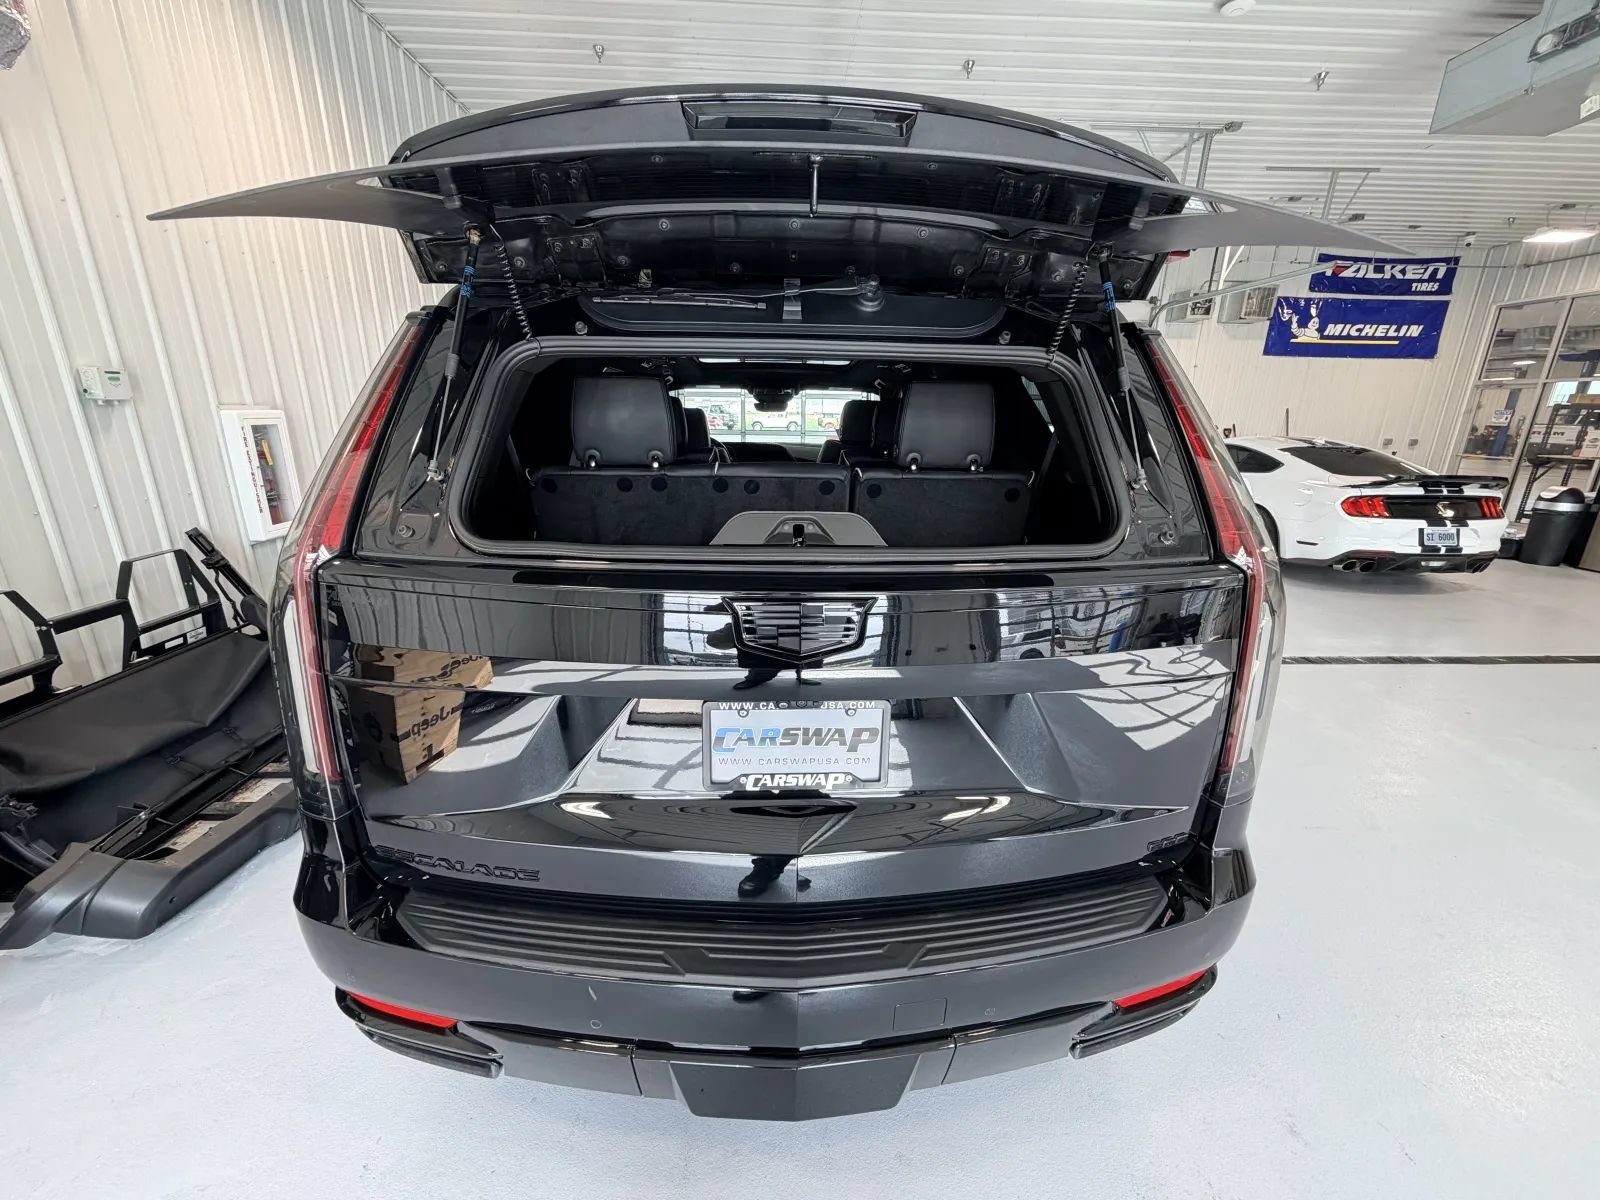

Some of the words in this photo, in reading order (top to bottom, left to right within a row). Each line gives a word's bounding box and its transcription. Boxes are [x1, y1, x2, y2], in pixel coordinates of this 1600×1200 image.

[1325, 260, 1447, 280] FALKEN
[1411, 282, 1440, 292] TIRES
[1324, 323, 1425, 338] MICHELIN
[1438, 533, 1455, 541] 6000
[718, 701, 876, 711] WWW.CAUSA.COM
[712, 727, 880, 753] CARSWAP
[745, 773, 845, 791] CARSWAP
[374, 844, 541, 882] ESCALADE
